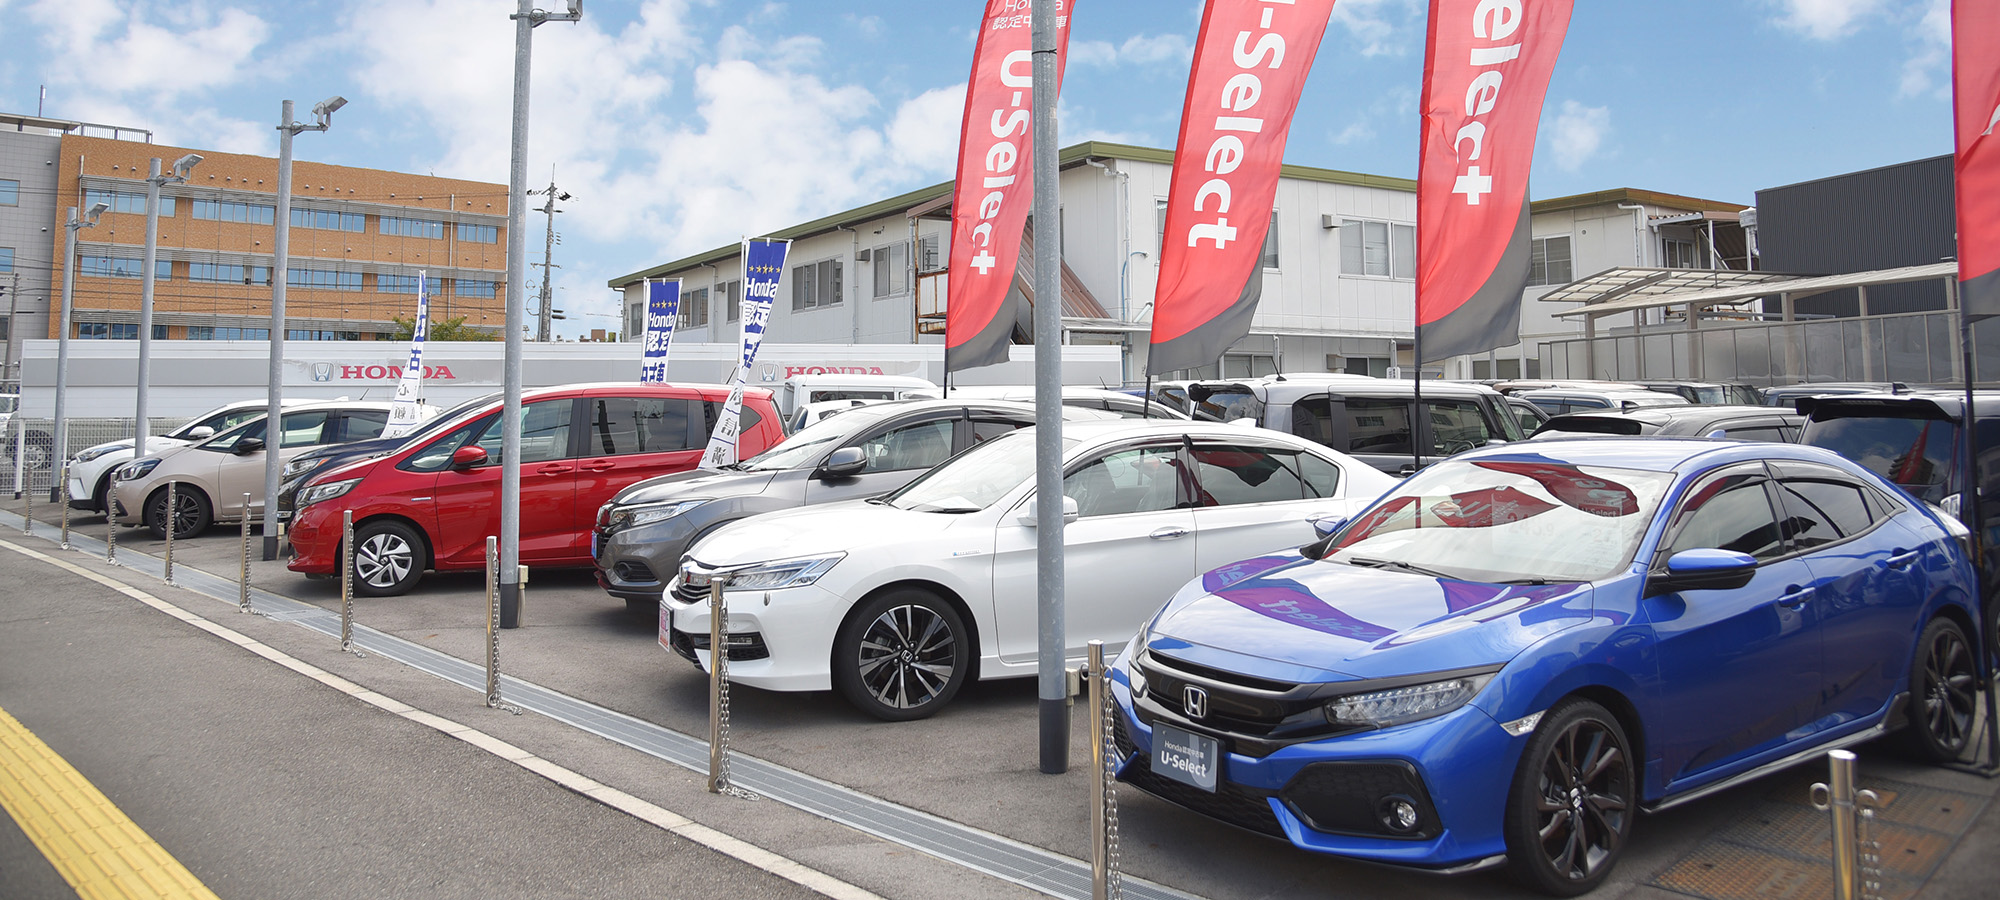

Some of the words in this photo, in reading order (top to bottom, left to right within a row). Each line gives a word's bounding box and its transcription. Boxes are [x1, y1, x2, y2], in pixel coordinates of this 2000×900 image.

[1188, 0, 1295, 249] -Select
[970, 50, 1032, 275] U-Select
[746, 278, 779, 298] Honda
[648, 312, 675, 328] Honda
[1161, 750, 1206, 778] U-Select
